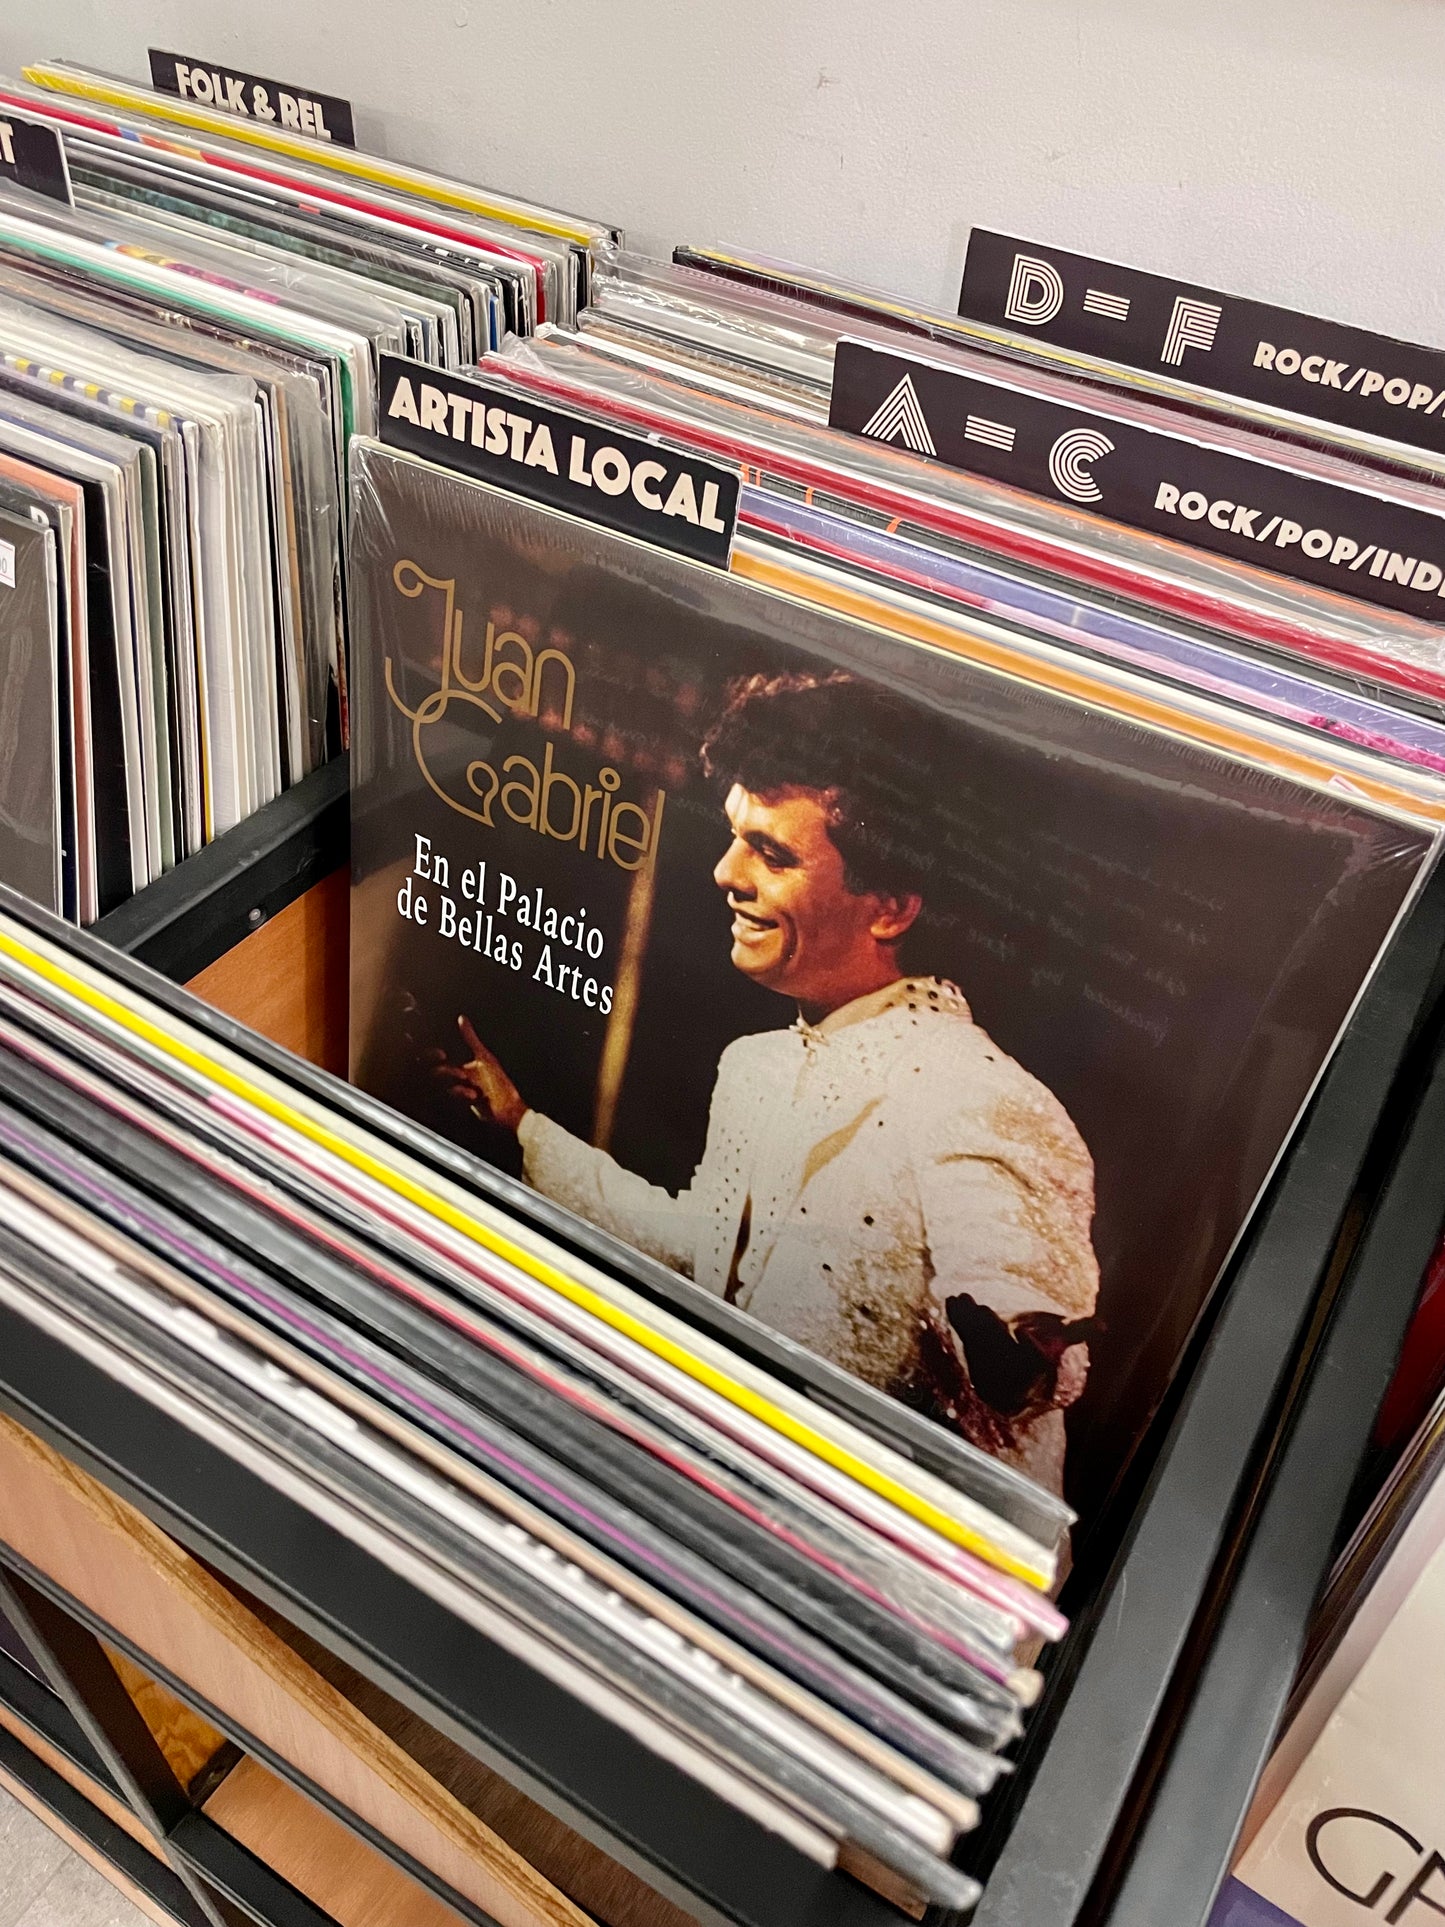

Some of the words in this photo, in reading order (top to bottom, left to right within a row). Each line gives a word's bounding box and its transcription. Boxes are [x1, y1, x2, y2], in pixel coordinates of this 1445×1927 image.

[175, 62, 249, 114] FOLK
[252, 85, 276, 121] &
[278, 92, 332, 142] REL
[1004, 253, 1064, 326] D
[1160, 296, 1223, 367] F
[1252, 341, 1445, 419] ROCK/POP/
[388, 376, 560, 476] ARTISTA
[568, 435, 726, 534] LOCAL
[861, 372, 938, 457] A
[1048, 427, 1116, 503] C
[385, 559, 575, 730] Juan
[413, 689, 666, 874] Gabriel
[396, 876, 428, 925] de
[438, 894, 523, 971] Bellas
[532, 944, 614, 1015] Artes
[413, 833, 450, 889] En
[461, 861, 486, 906] el
[496, 872, 604, 959] Palacio
